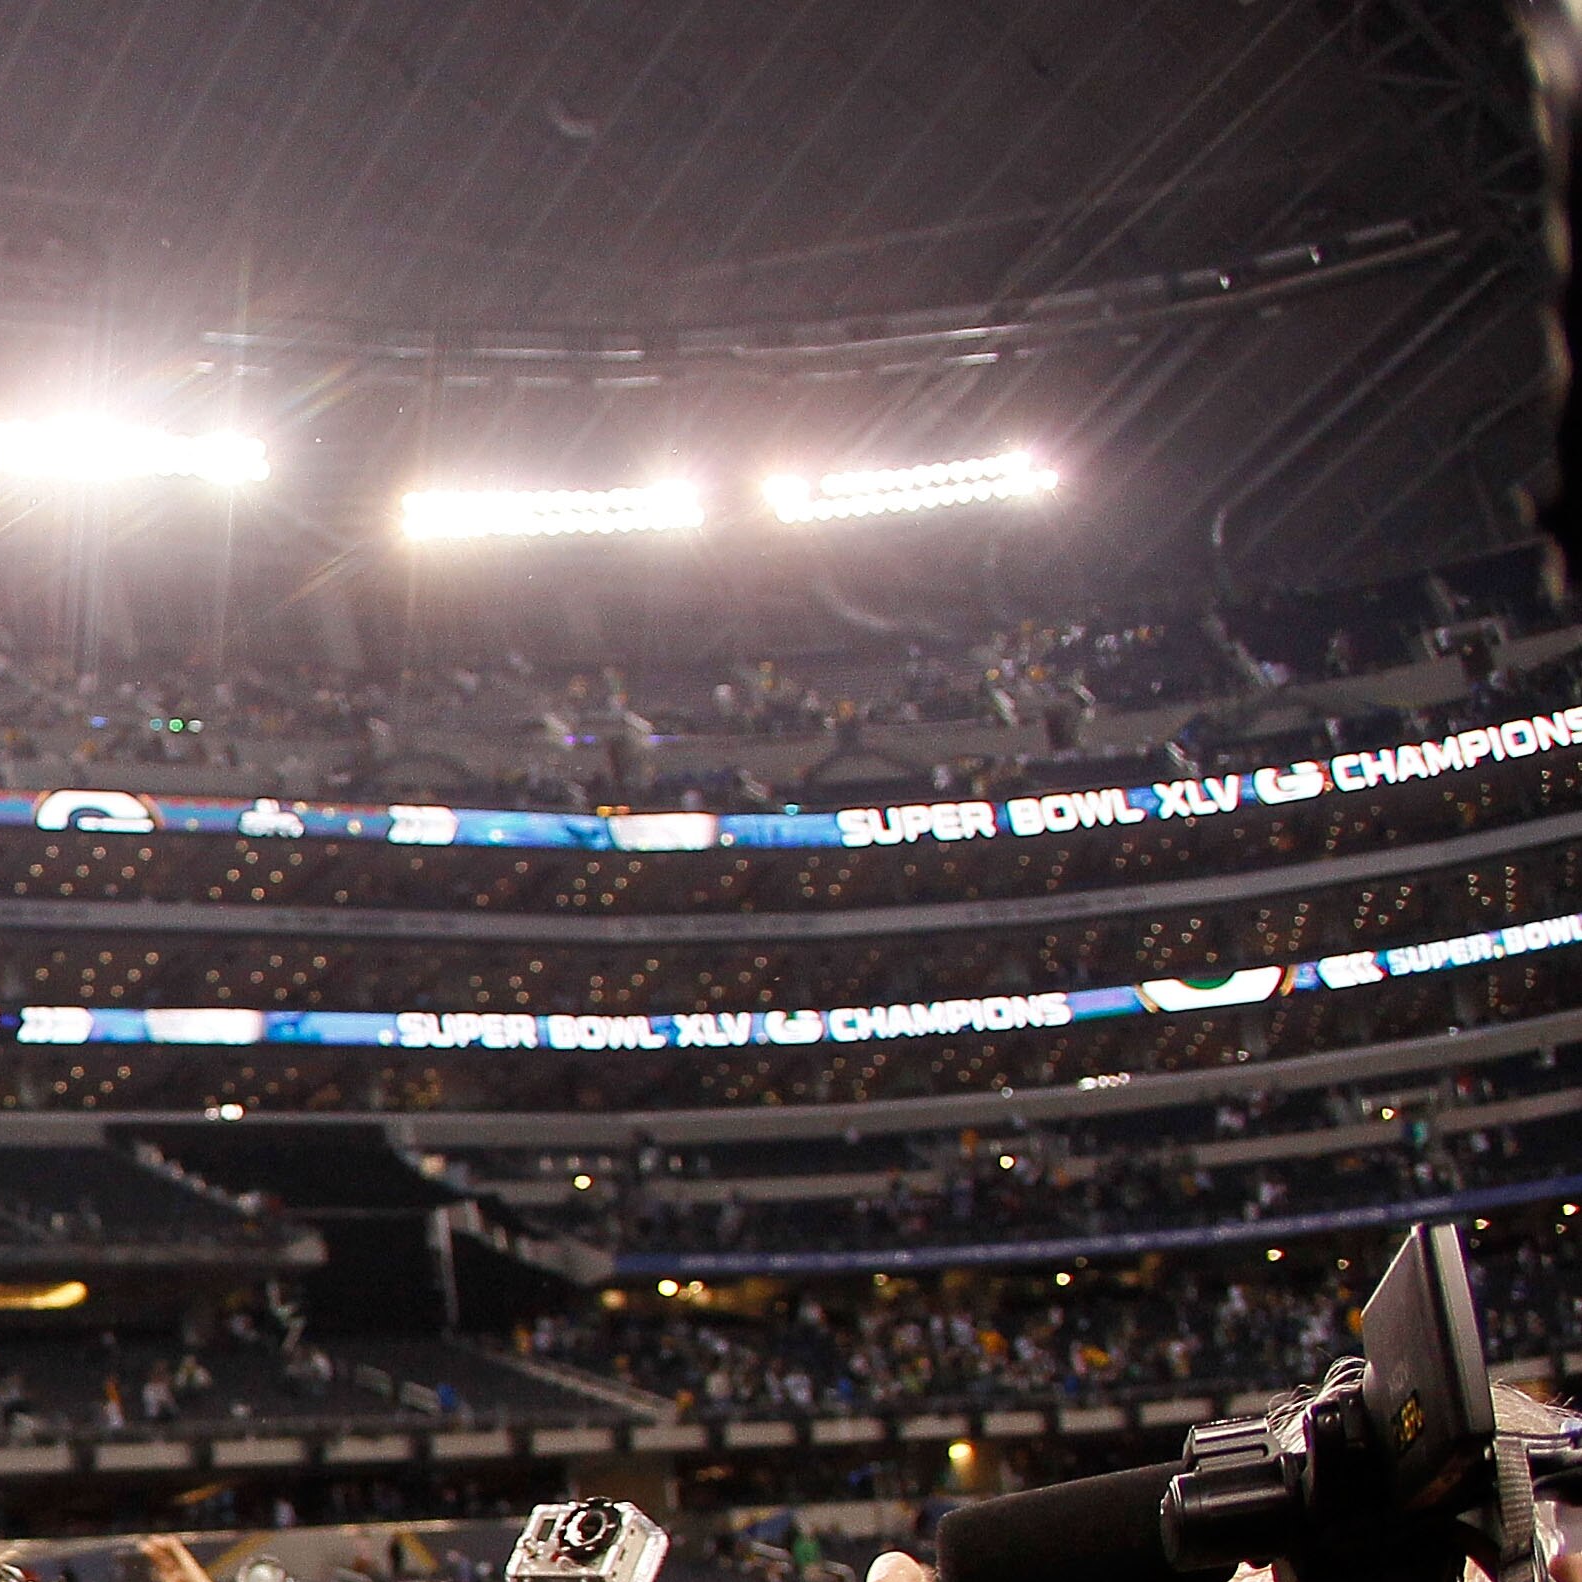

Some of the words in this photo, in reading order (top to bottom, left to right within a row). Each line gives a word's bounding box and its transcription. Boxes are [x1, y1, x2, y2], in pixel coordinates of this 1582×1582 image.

[835, 800, 997, 847] SUPER
[1006, 785, 1145, 838] BOWL
[1152, 774, 1241, 822] XLV
[1386, 932, 1492, 976] SUPER
[395, 1010, 539, 1048] SUPER
[546, 1013, 667, 1050] BOWL
[674, 1012, 753, 1048] XLV
[828, 992, 1074, 1044] CHAMPIONS
